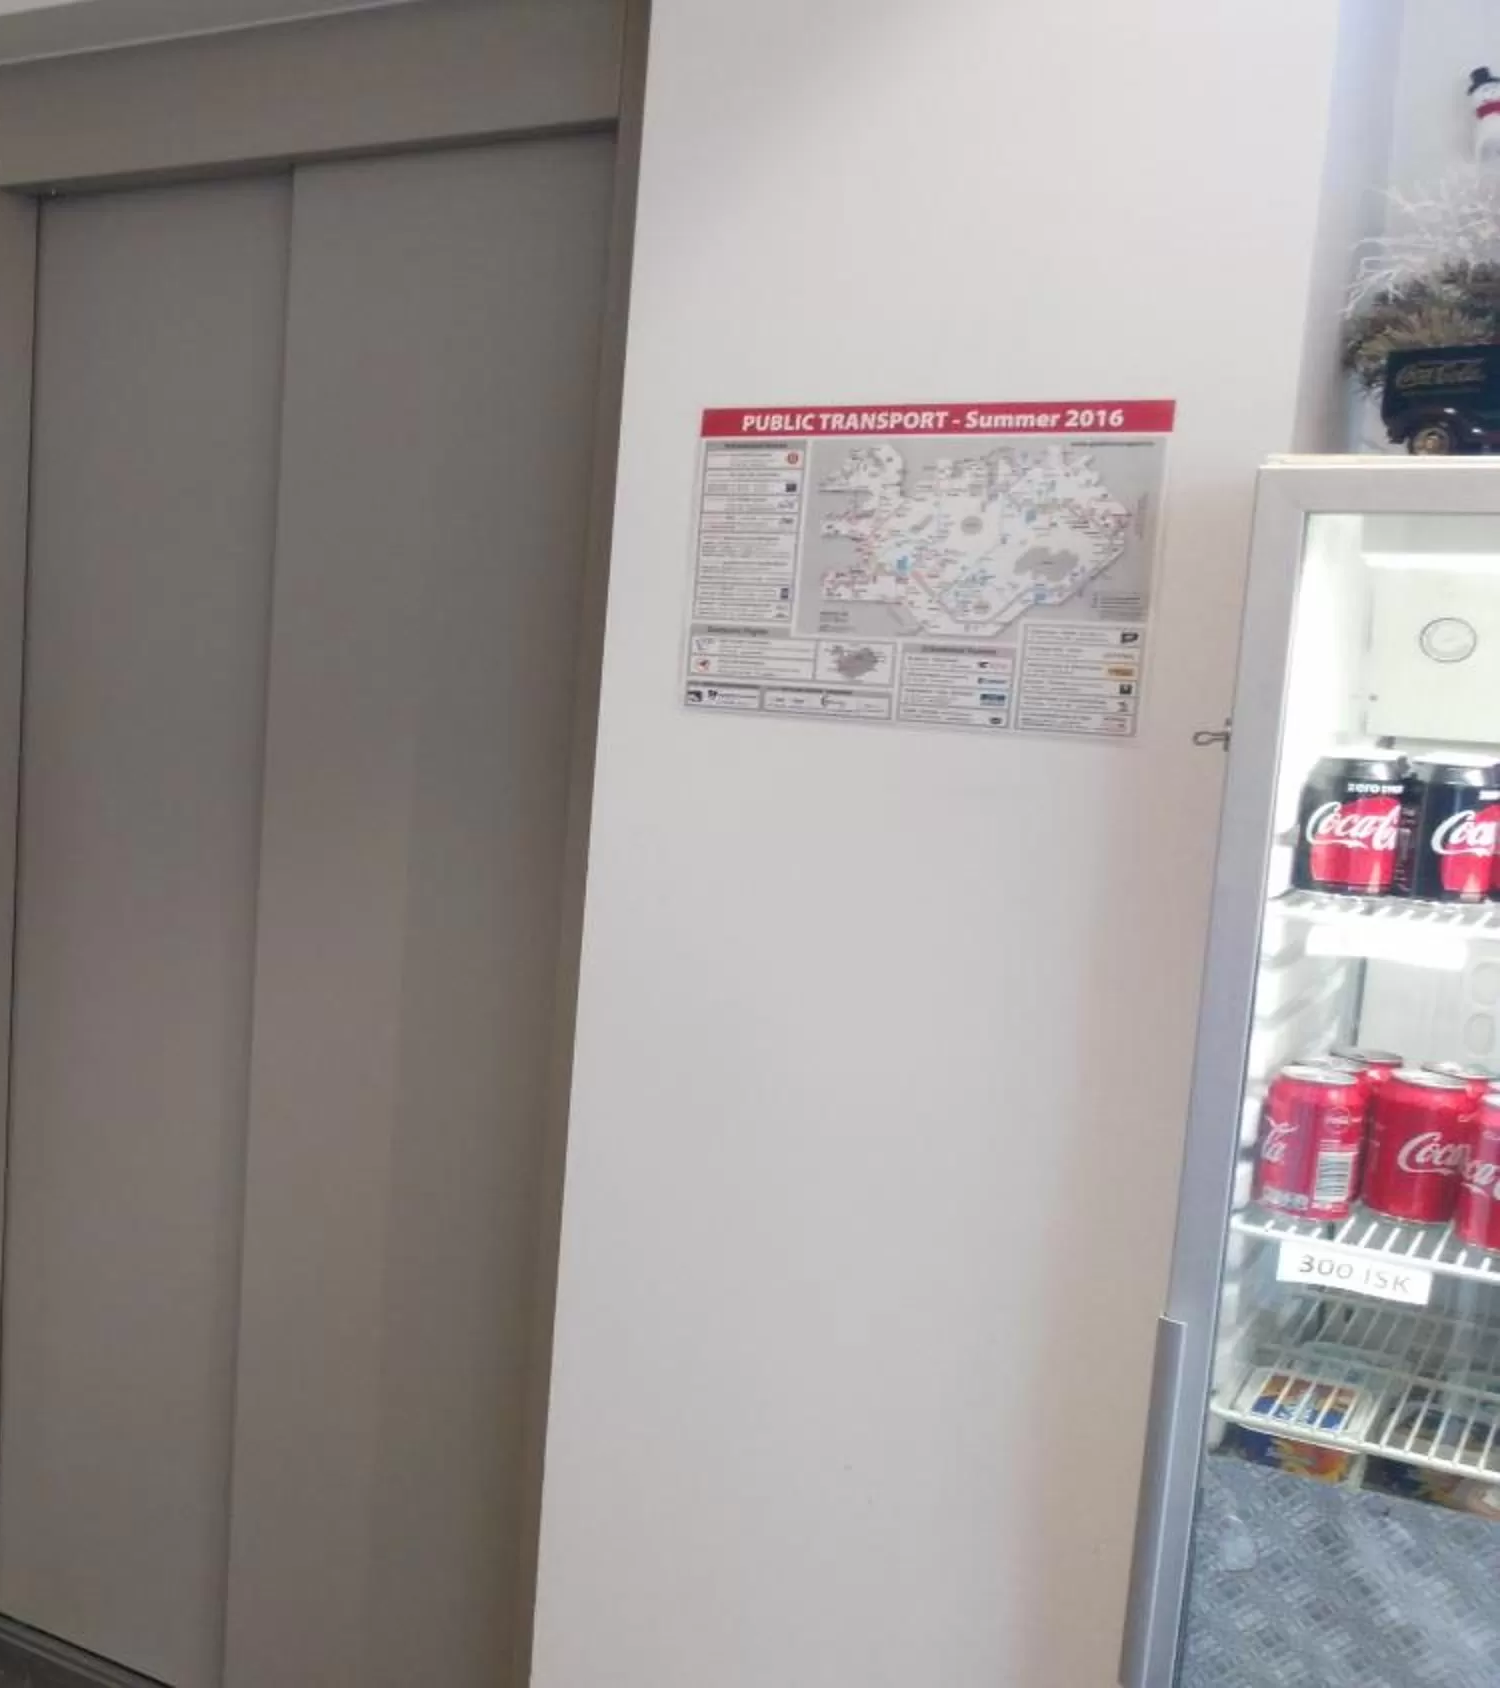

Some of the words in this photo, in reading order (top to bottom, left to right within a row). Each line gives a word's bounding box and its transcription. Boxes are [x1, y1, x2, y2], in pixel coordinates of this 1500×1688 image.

[741, 413, 816, 432] PUBLIC
[818, 411, 949, 430] TRANSPORT
[964, 410, 1061, 430] Summer
[1064, 408, 1125, 429] 2016
[1298, 1254, 1354, 1280] 300
[1363, 1267, 1411, 1295] ISK
